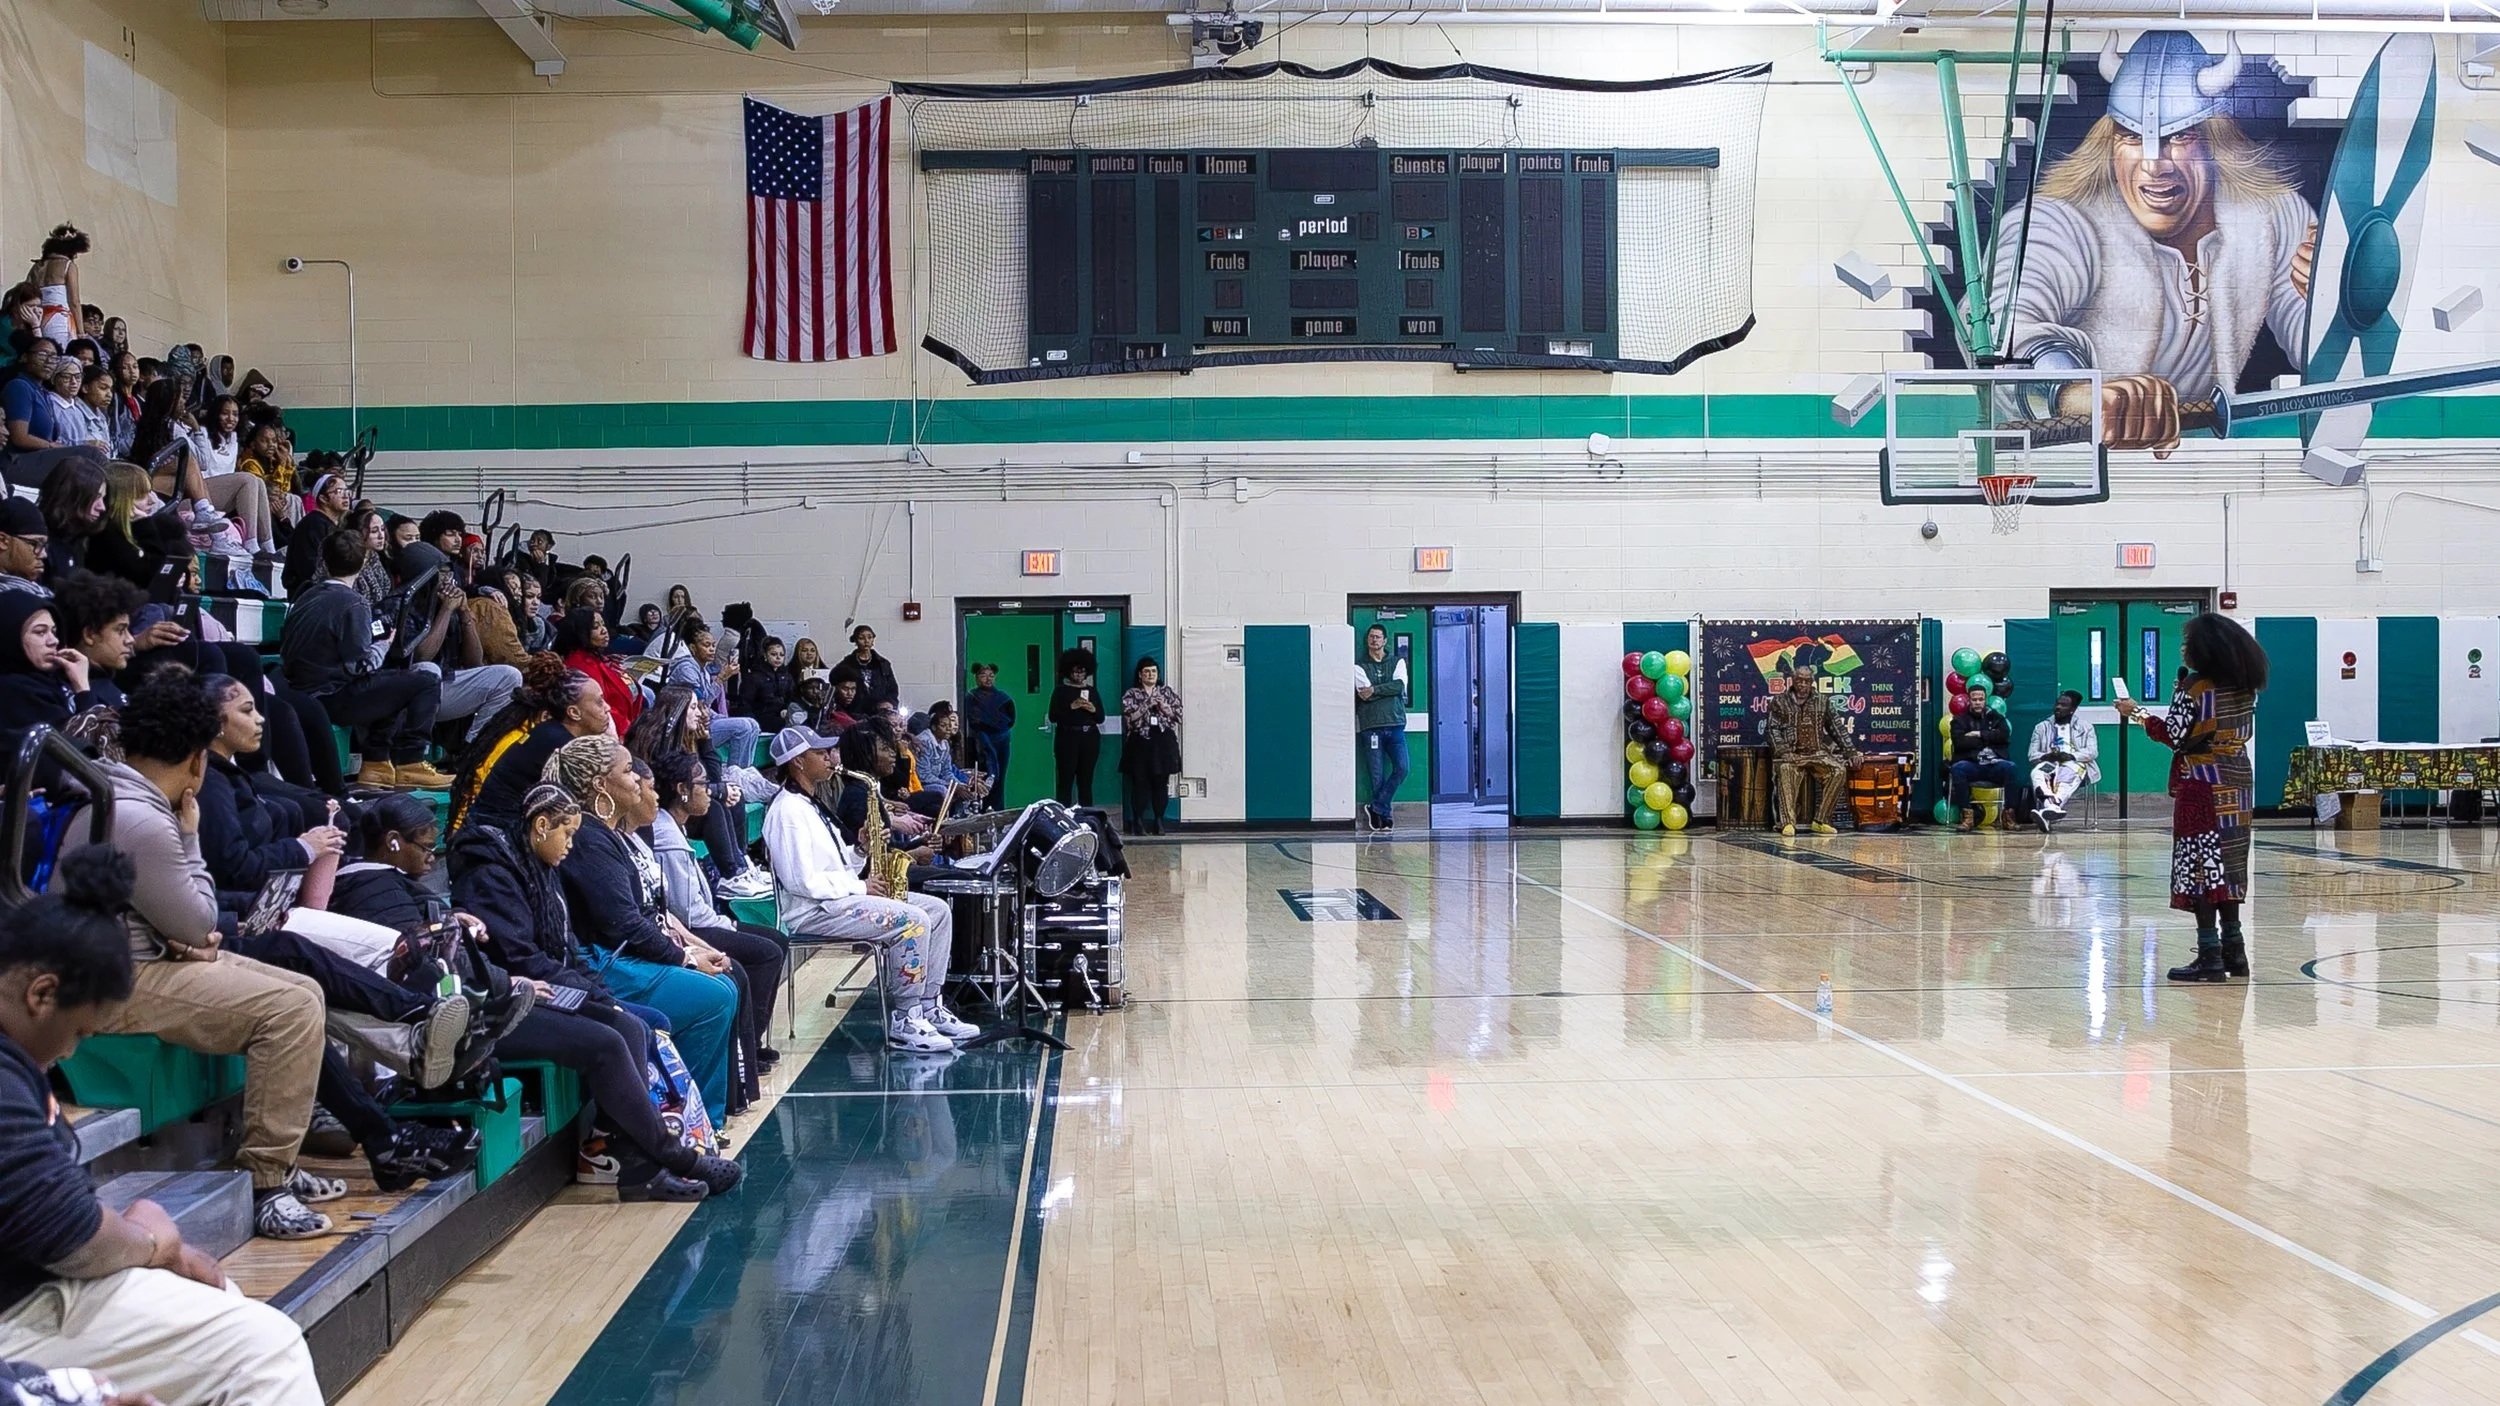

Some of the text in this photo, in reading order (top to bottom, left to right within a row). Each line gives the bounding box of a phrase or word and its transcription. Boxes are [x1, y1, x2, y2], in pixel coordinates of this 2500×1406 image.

[1032, 156, 1073, 175] player
[1092, 156, 1135, 175] points
[1149, 156, 1183, 173] fouls
[1205, 156, 1247, 174] Home
[1393, 156, 1445, 174] Guests
[1459, 154, 1500, 173] player
[1519, 155, 1562, 174] points
[1575, 156, 1609, 172] fouls
[1299, 216, 1348, 237] period
[1210, 252, 1245, 269] fouls
[1300, 251, 1348, 271] player
[1405, 252, 1440, 269] fouls
[1212, 320, 1241, 333] won
[1305, 320, 1343, 337] game
[1407, 320, 1436, 333] won
[2308, 391, 2354, 407] VIKINGS
[1028, 552, 1056, 573] EXIT
[1421, 549, 1448, 570] EXIT
[1719, 683, 1741, 692] BUILD
[1871, 683, 1894, 692] THINK
[1719, 695, 1741, 704] SPEAK
[1720, 707, 1745, 716] DREAM
[1871, 706, 1902, 715] EDUCATE
[1720, 720, 1739, 729] LEAD
[1871, 720, 1911, 729] CHALLENGE
[1720, 734, 1741, 743] FIGHT
